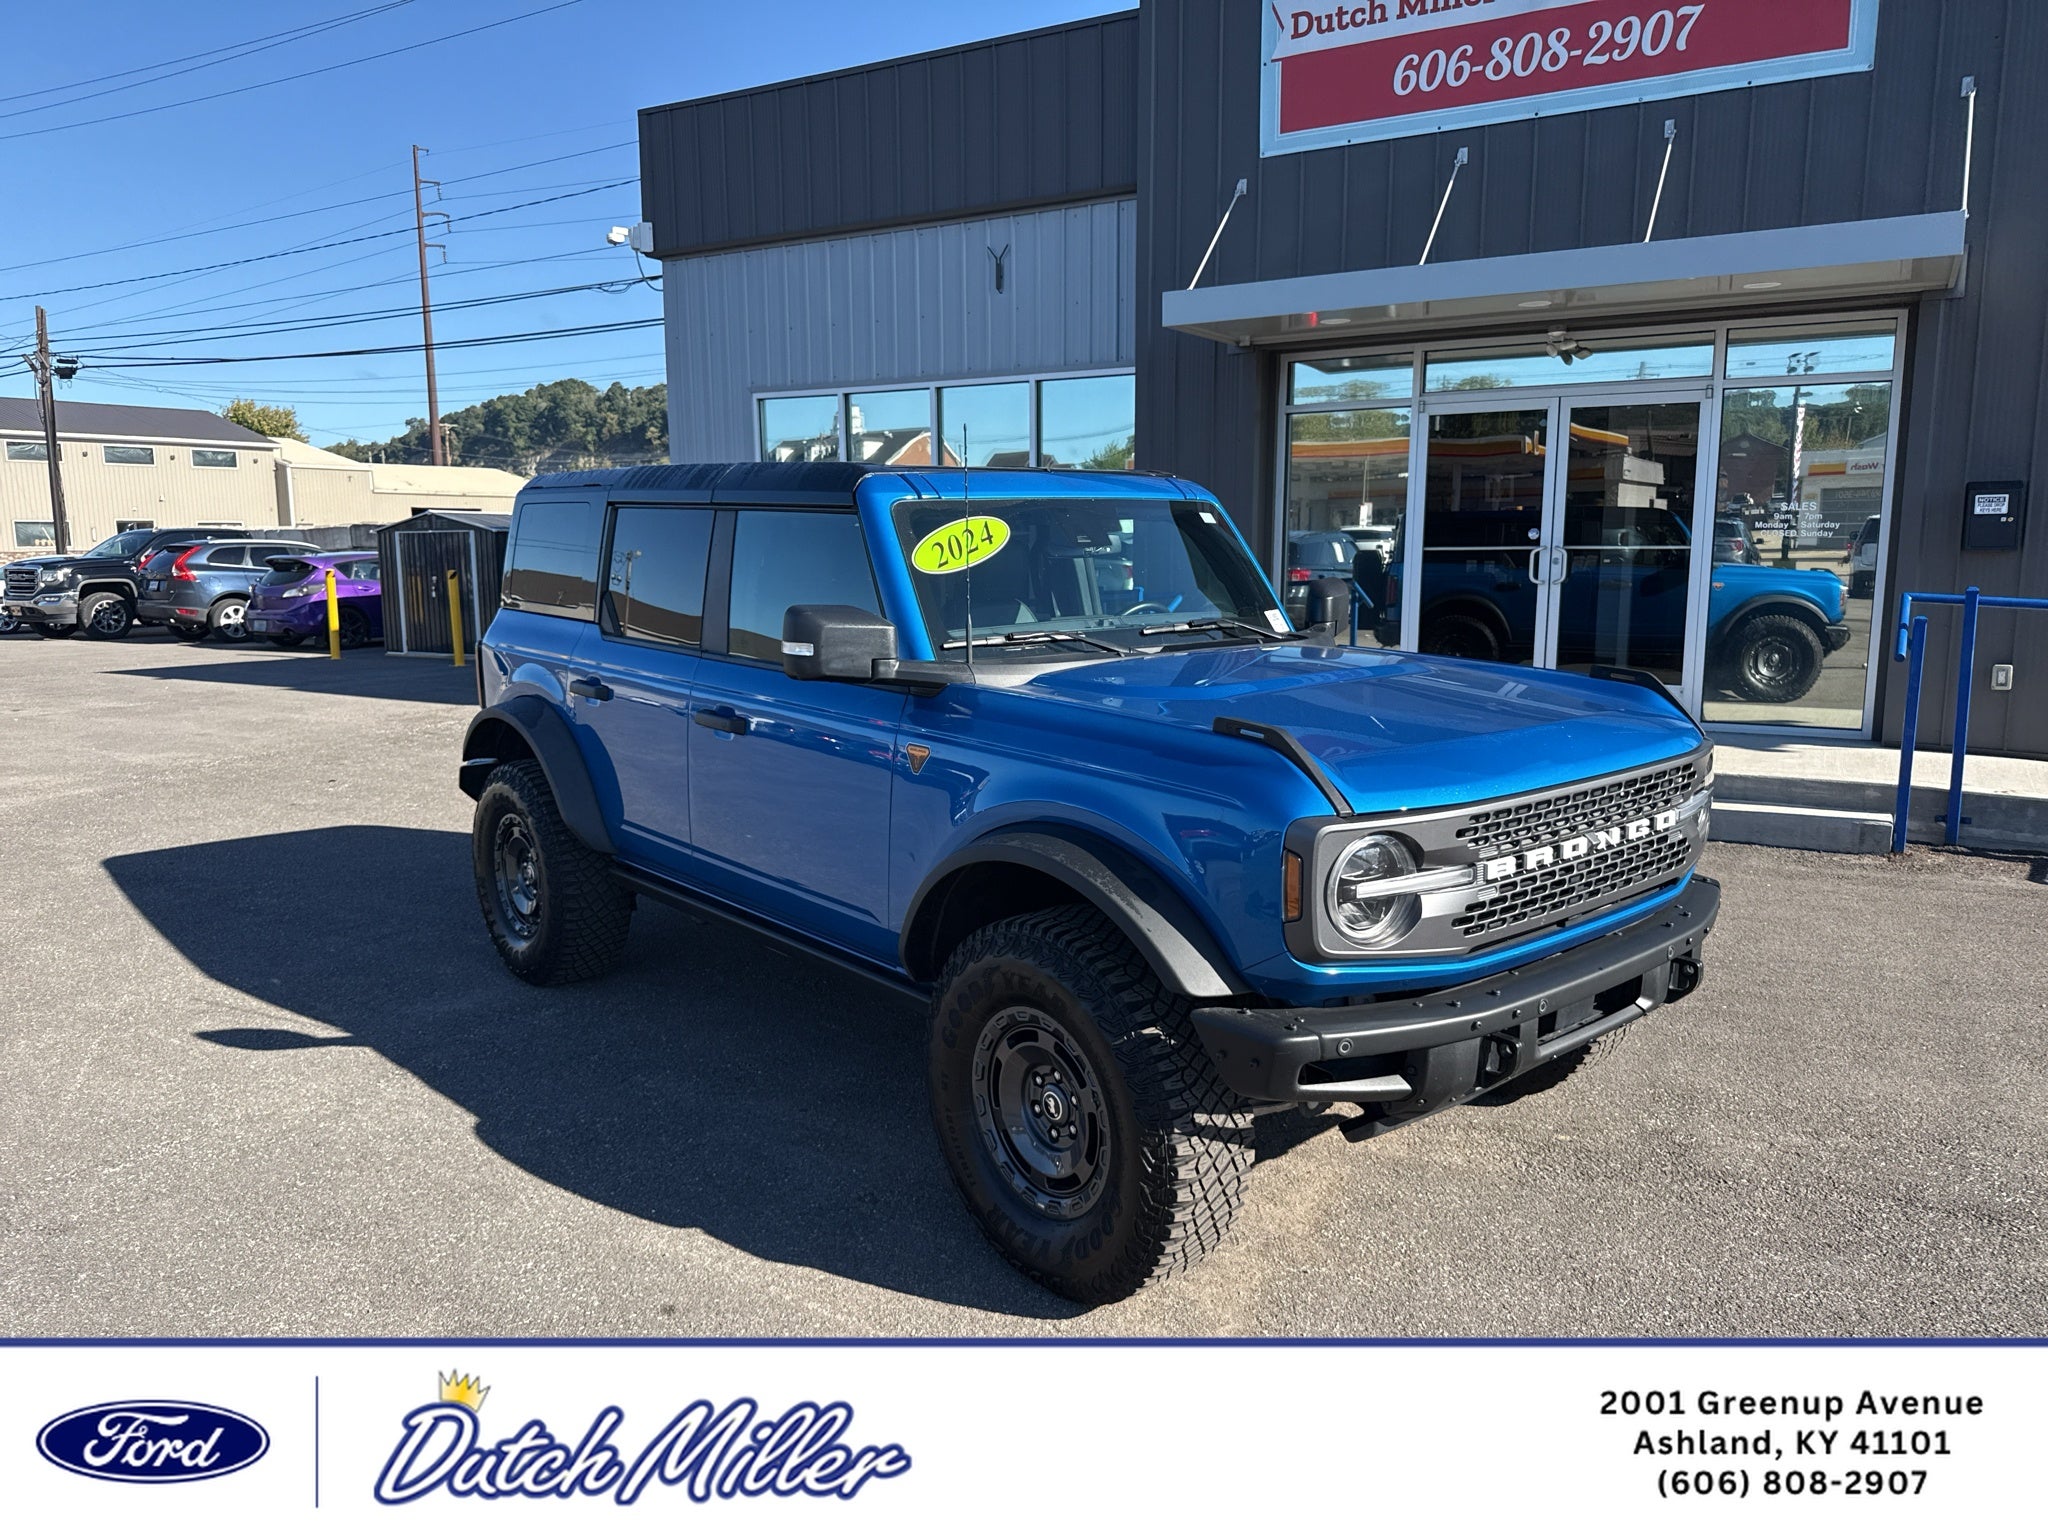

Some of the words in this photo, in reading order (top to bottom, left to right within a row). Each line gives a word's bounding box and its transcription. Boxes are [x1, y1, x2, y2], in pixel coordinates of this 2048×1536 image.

[1291, 0, 1389, 40] Dutch
[1393, 4, 1704, 96] 606-808-2907
[1774, 512, 1793, 520] 9am
[1804, 512, 1823, 521] 7pm
[1781, 502, 1817, 511] SALES
[1755, 521, 1789, 529] Monday
[1800, 521, 1841, 529] Saturday
[1800, 530, 1834, 538] Sunday
[931, 520, 994, 569] 2024
[1486, 809, 1676, 881] BRONCO
